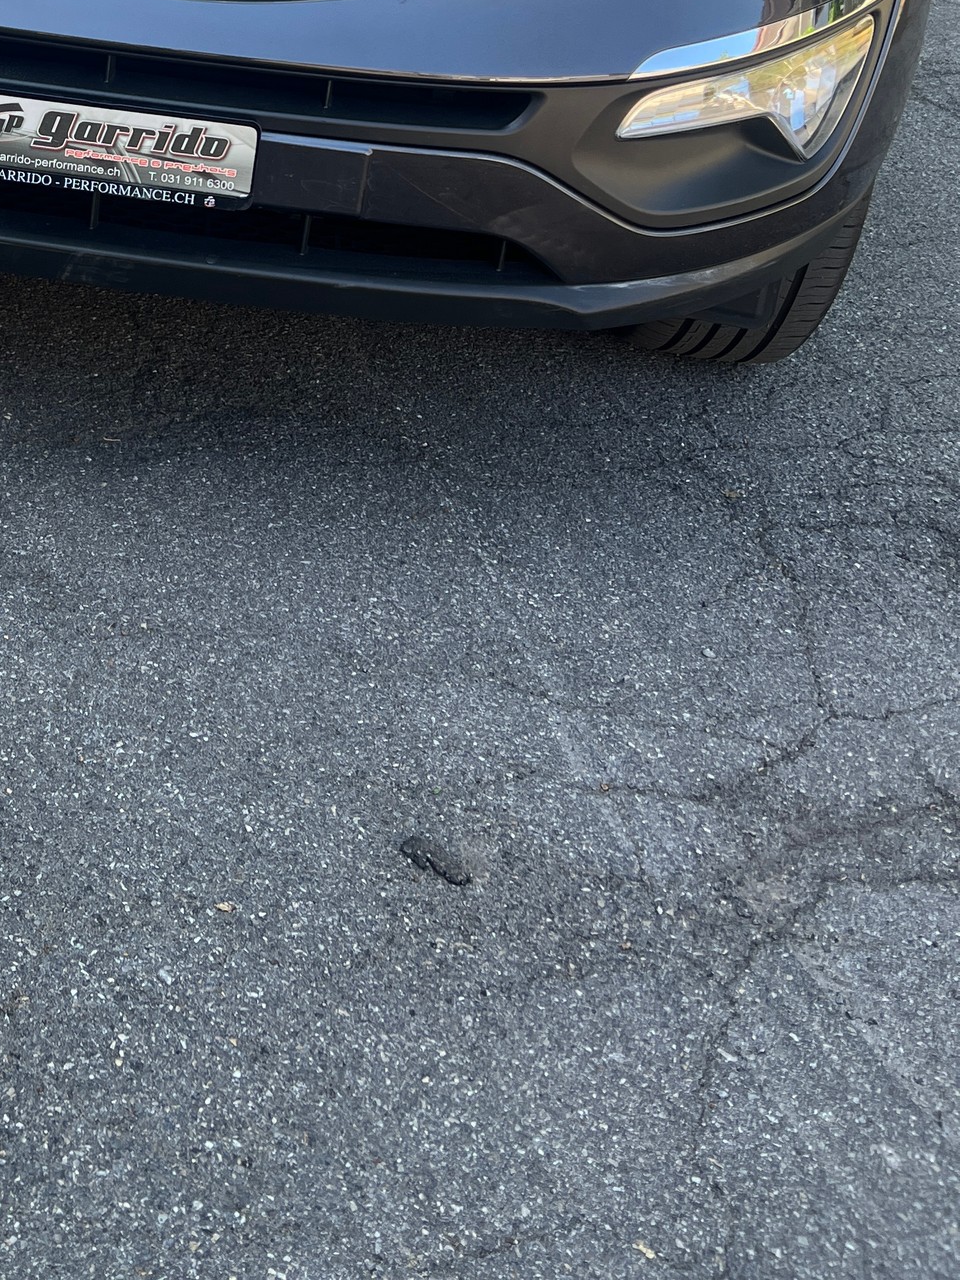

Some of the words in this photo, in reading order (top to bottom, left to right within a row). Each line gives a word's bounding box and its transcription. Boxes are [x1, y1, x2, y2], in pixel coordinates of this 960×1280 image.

[30, 109, 232, 160] garrido
[64, 147, 149, 167] performance
[163, 160, 238, 178] pneuhaus
[63, 177, 196, 206] PERFORMANCE.CH
[148, 171, 159, 182] T.
[160, 172, 182, 185] 031
[184, 175, 204, 187] 911
[206, 179, 235, 191] 6300
